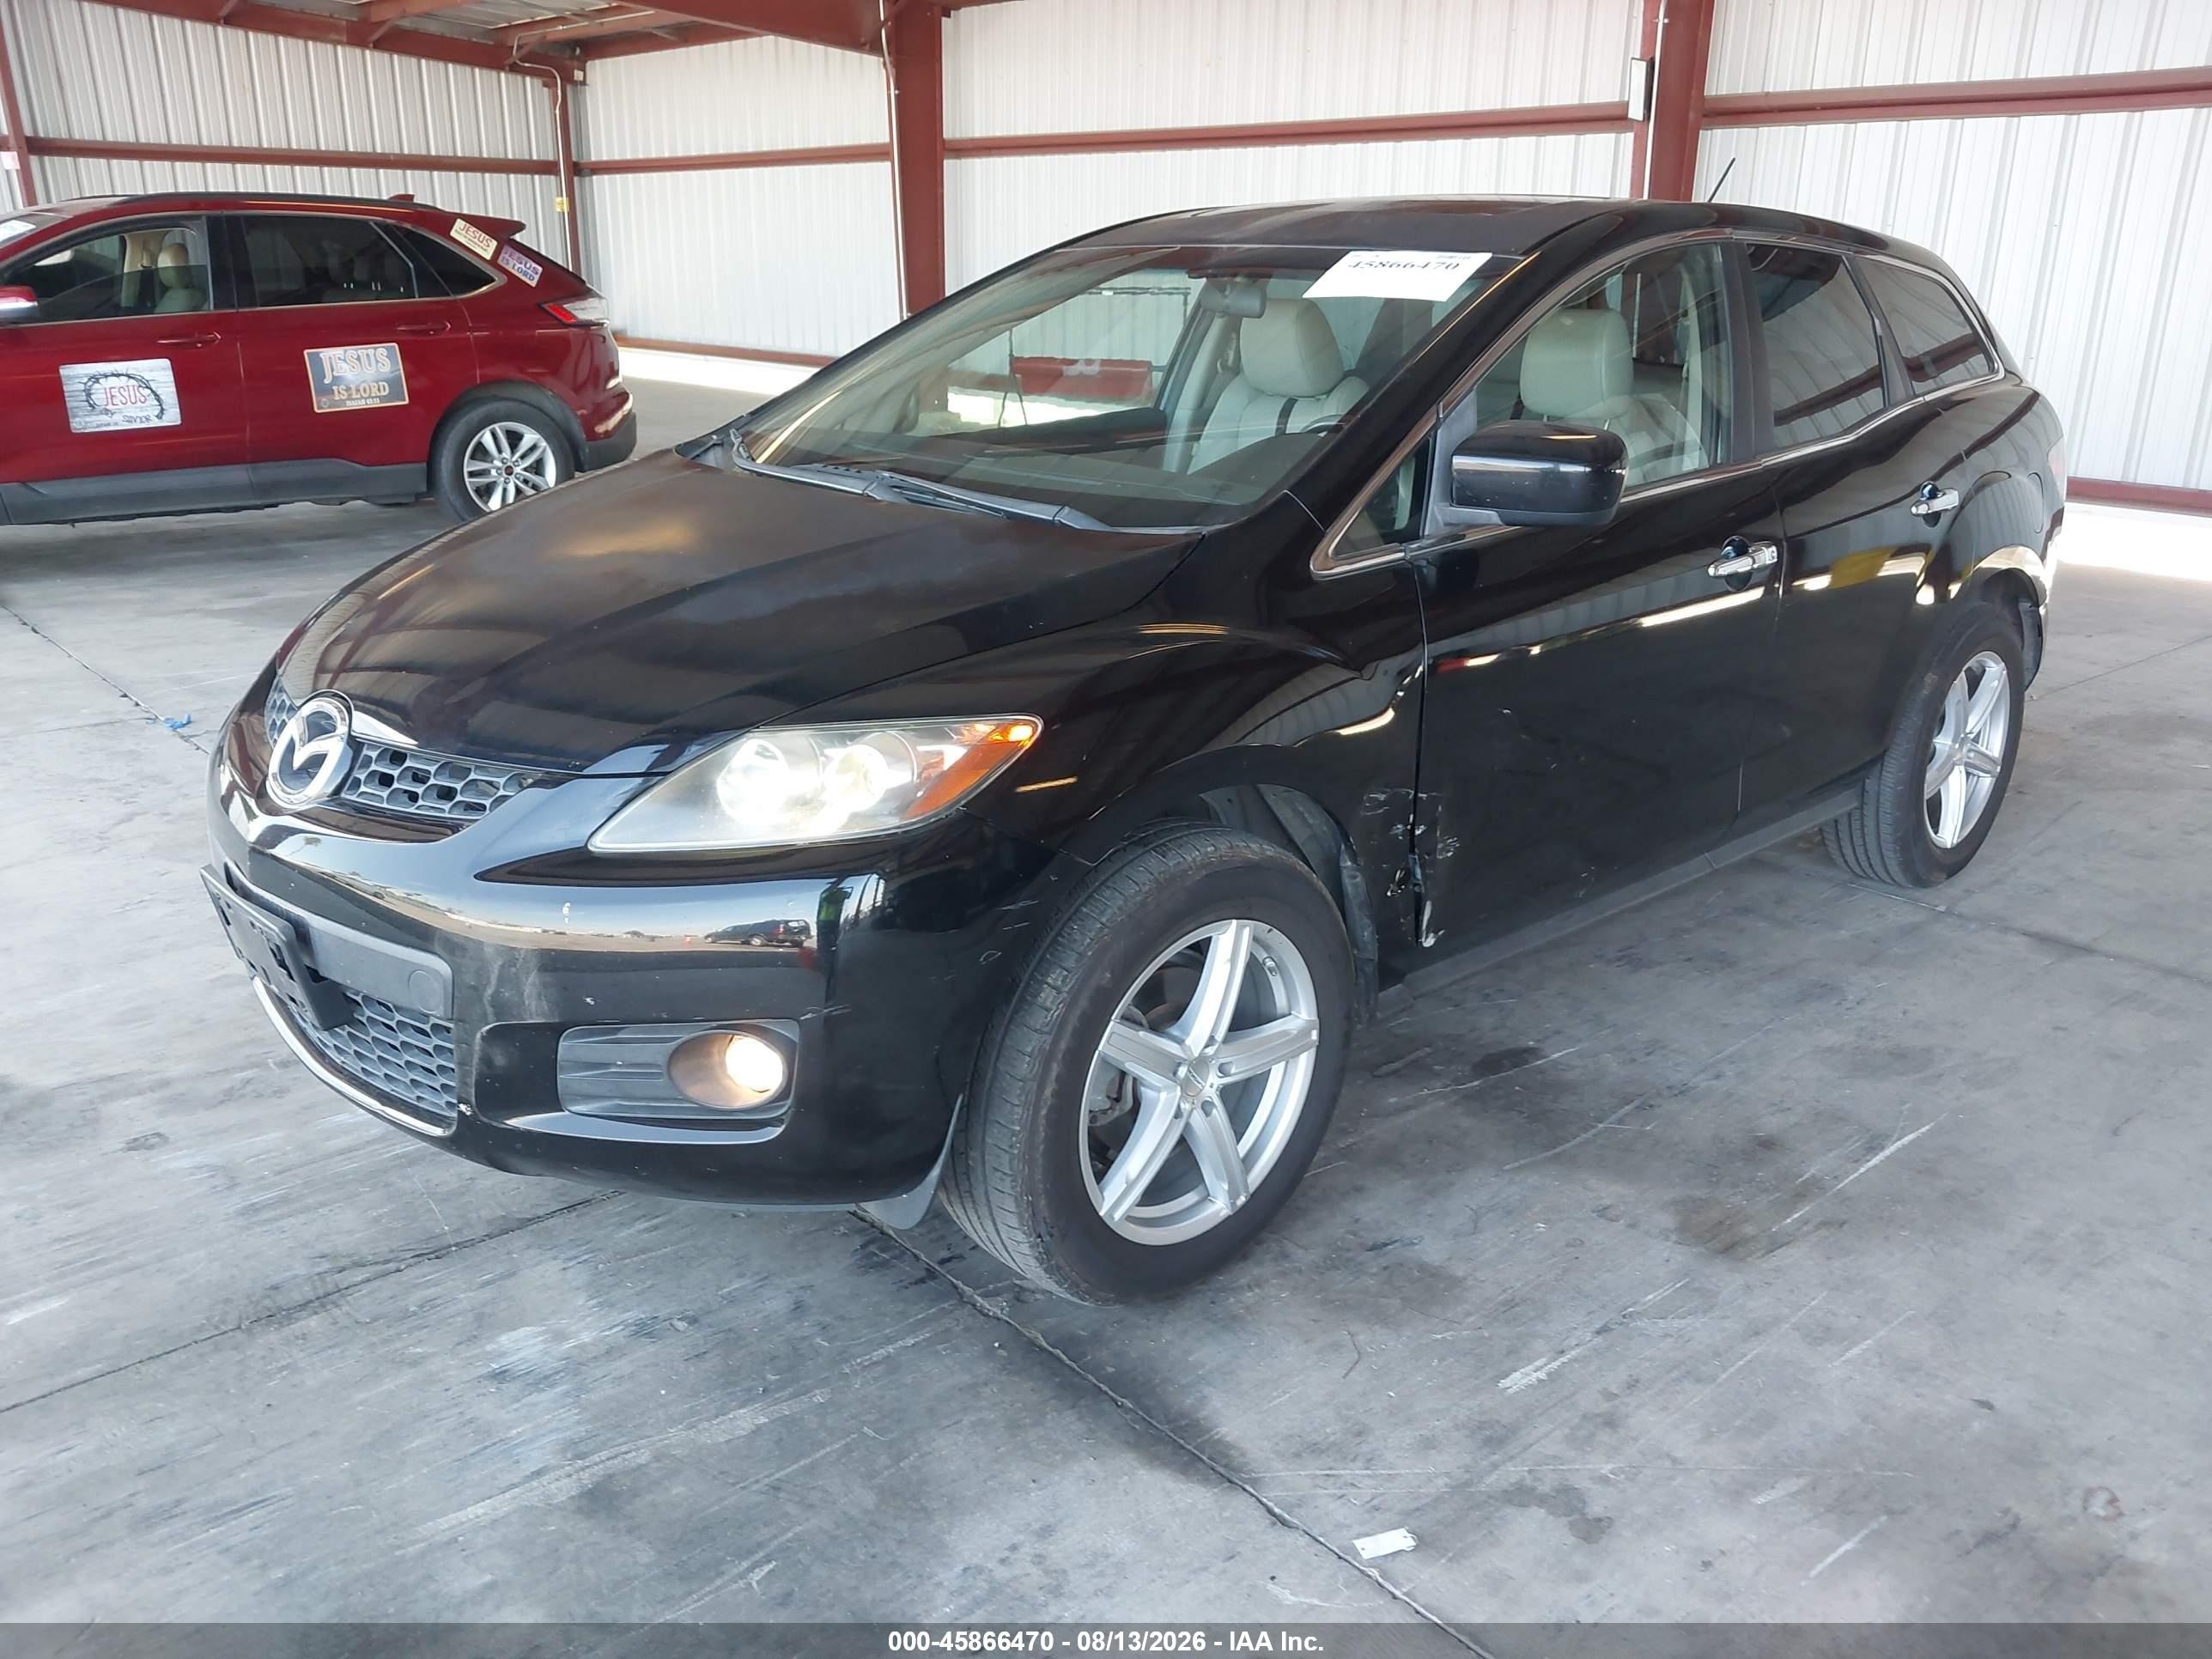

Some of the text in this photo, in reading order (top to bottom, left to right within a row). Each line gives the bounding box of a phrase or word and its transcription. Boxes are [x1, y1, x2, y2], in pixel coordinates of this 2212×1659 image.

[459, 223, 493, 248] JESUS
[503, 246, 540, 276] JESUS
[1348, 260, 1460, 270] 45866470
[512, 263, 535, 282] LORD
[319, 347, 392, 385] JESUS
[104, 385, 148, 407] JESUS
[332, 381, 391, 400] IS LORD
